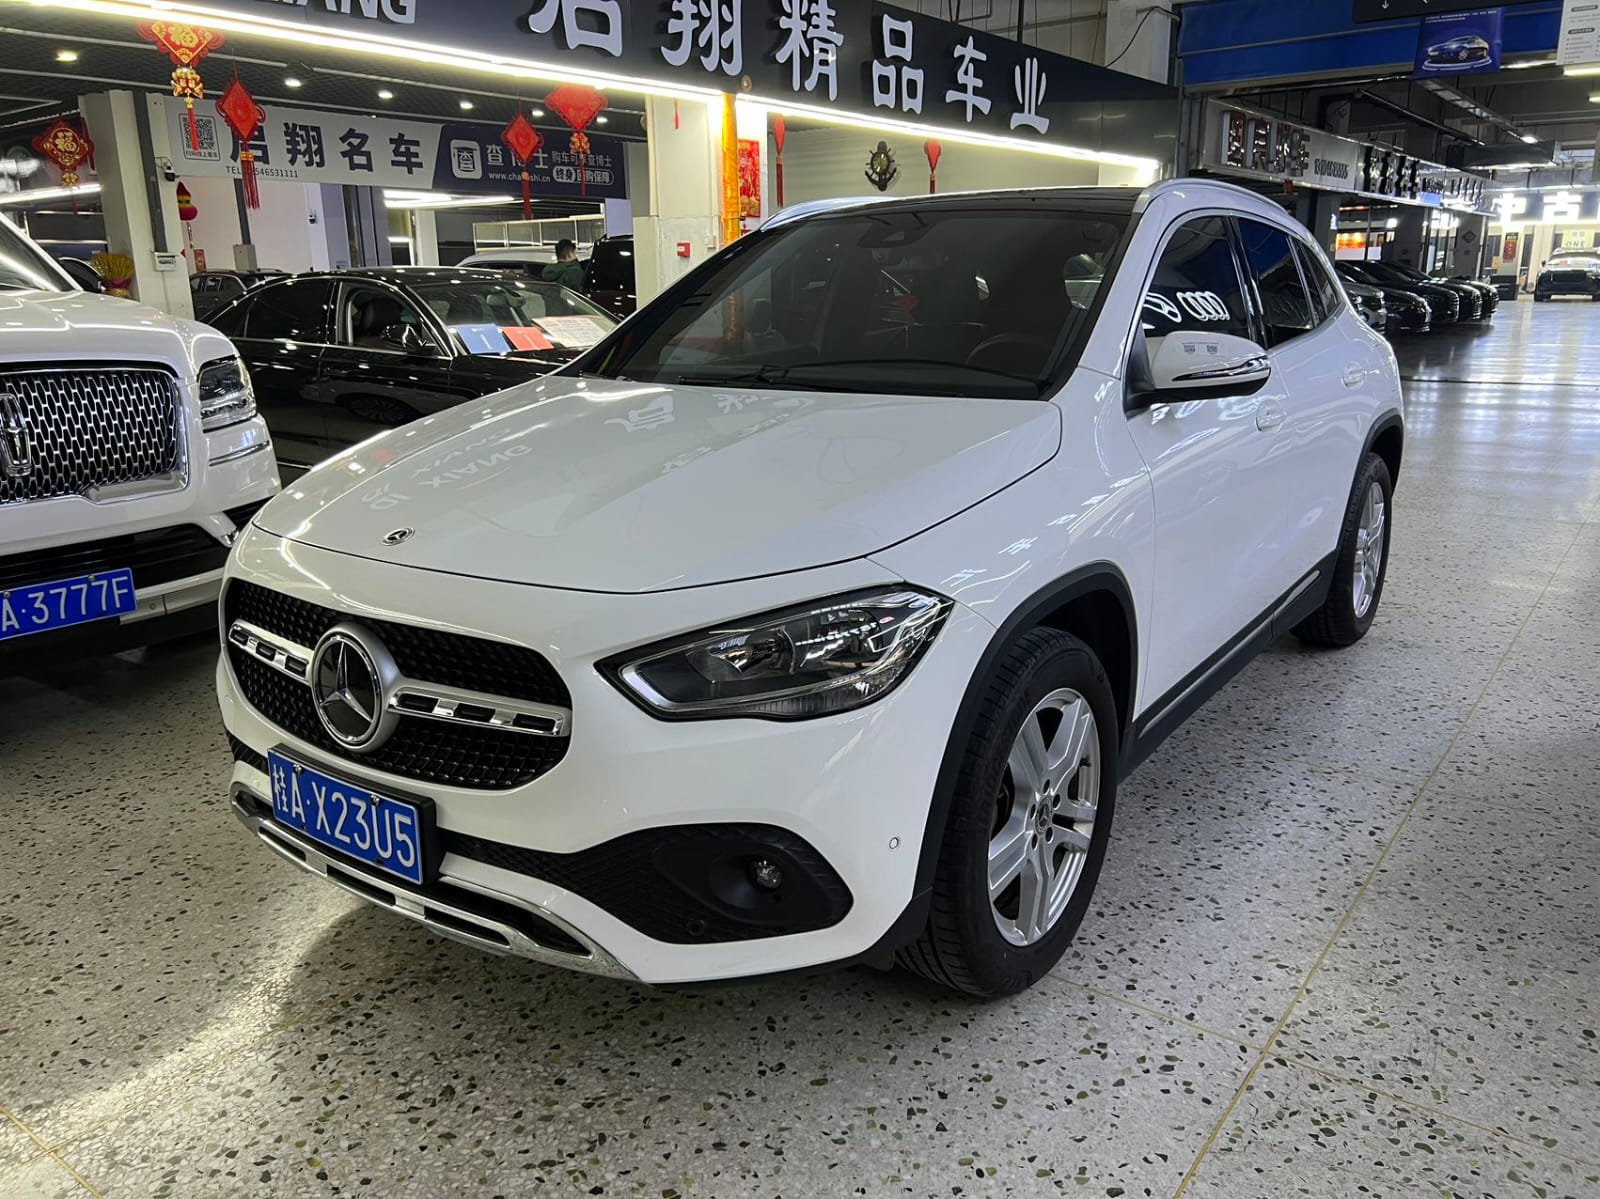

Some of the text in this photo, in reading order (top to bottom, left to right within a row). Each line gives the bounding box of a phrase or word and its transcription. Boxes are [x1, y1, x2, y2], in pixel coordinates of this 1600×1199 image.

[55, 131, 77, 151] 福
[486, 144, 549, 169] 查士
[551, 150, 612, 167] 购车可查博士
[488, 172, 551, 183] www.chashi.cn
